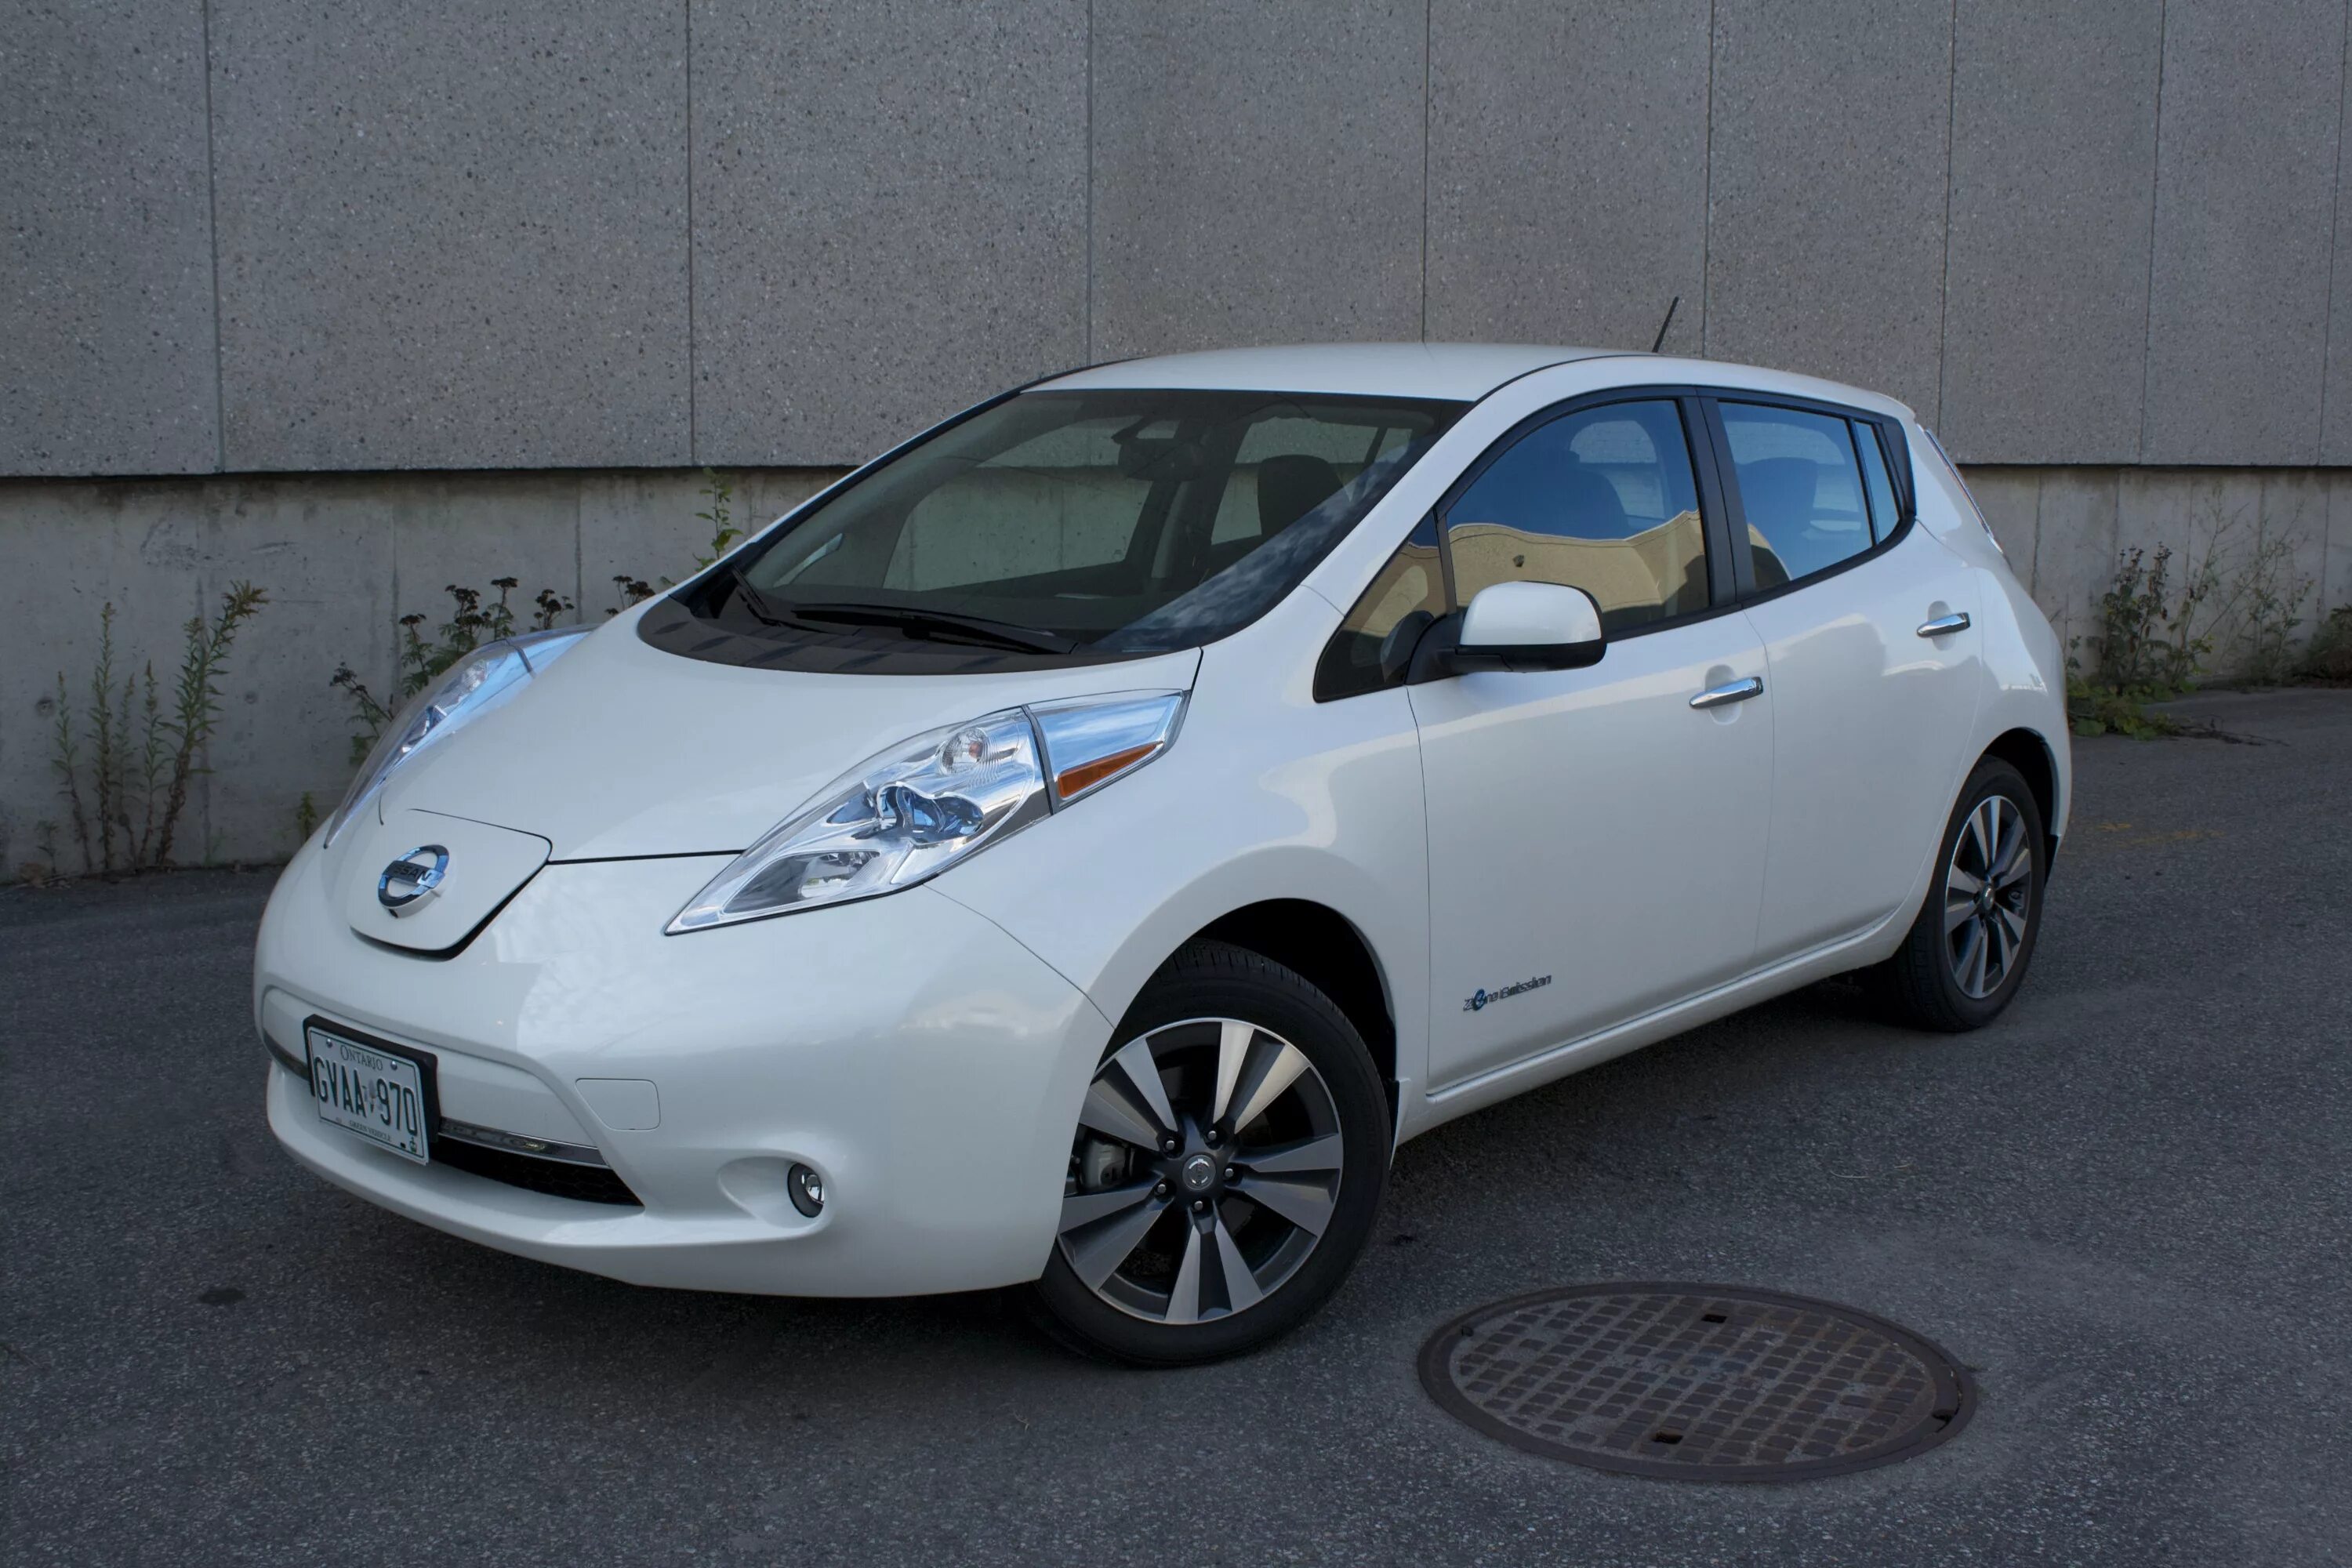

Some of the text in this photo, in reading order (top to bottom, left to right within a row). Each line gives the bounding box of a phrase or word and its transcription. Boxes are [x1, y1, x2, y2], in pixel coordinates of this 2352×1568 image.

[384, 862, 433, 882] SSAN
[1499, 975, 1552, 999] Emission
[339, 1044, 383, 1072] ONTARIO
